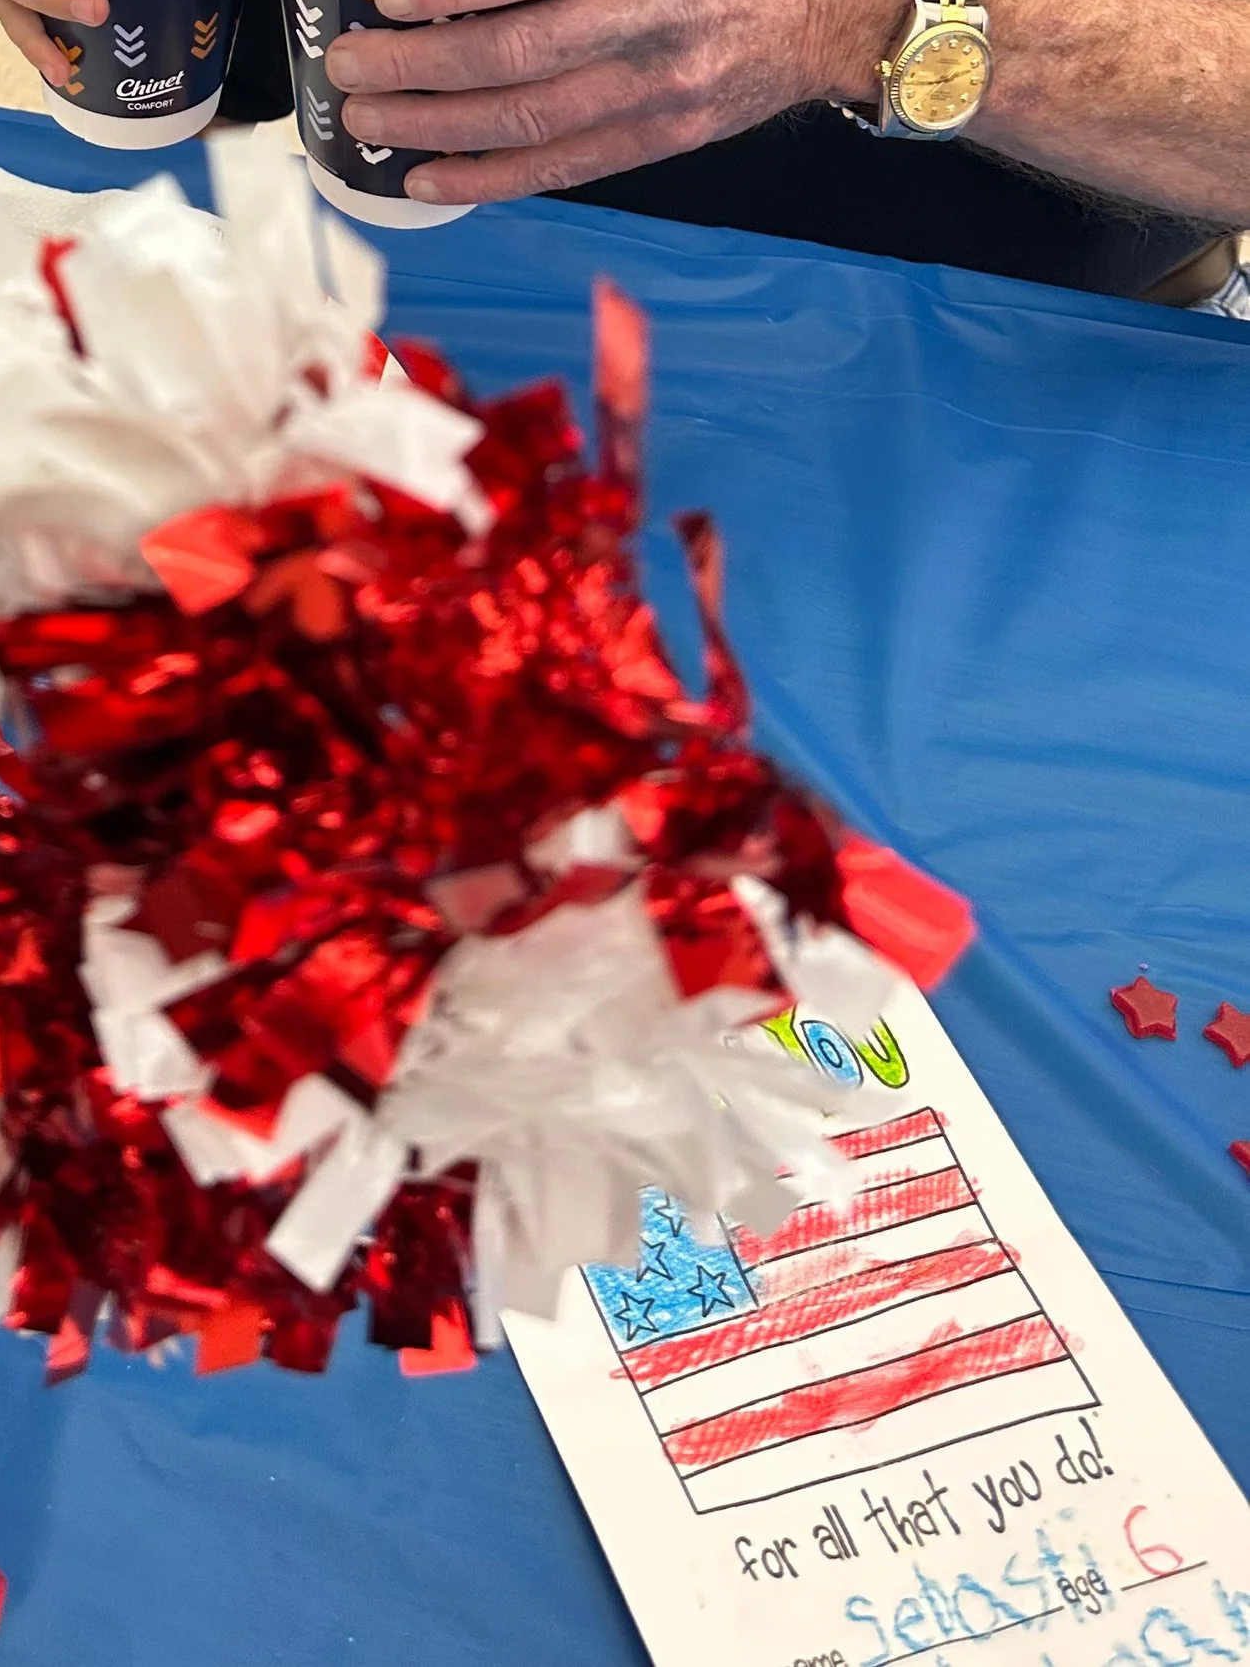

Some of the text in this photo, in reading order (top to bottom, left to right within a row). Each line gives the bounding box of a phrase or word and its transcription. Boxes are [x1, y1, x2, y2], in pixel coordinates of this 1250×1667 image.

[116, 70, 184, 98] Chinet
[127, 98, 174, 111] COMFORT
[734, 1416, 1114, 1581] for all that you do!
[1057, 1568, 1109, 1615] age
[1123, 1504, 1183, 1578] 6
